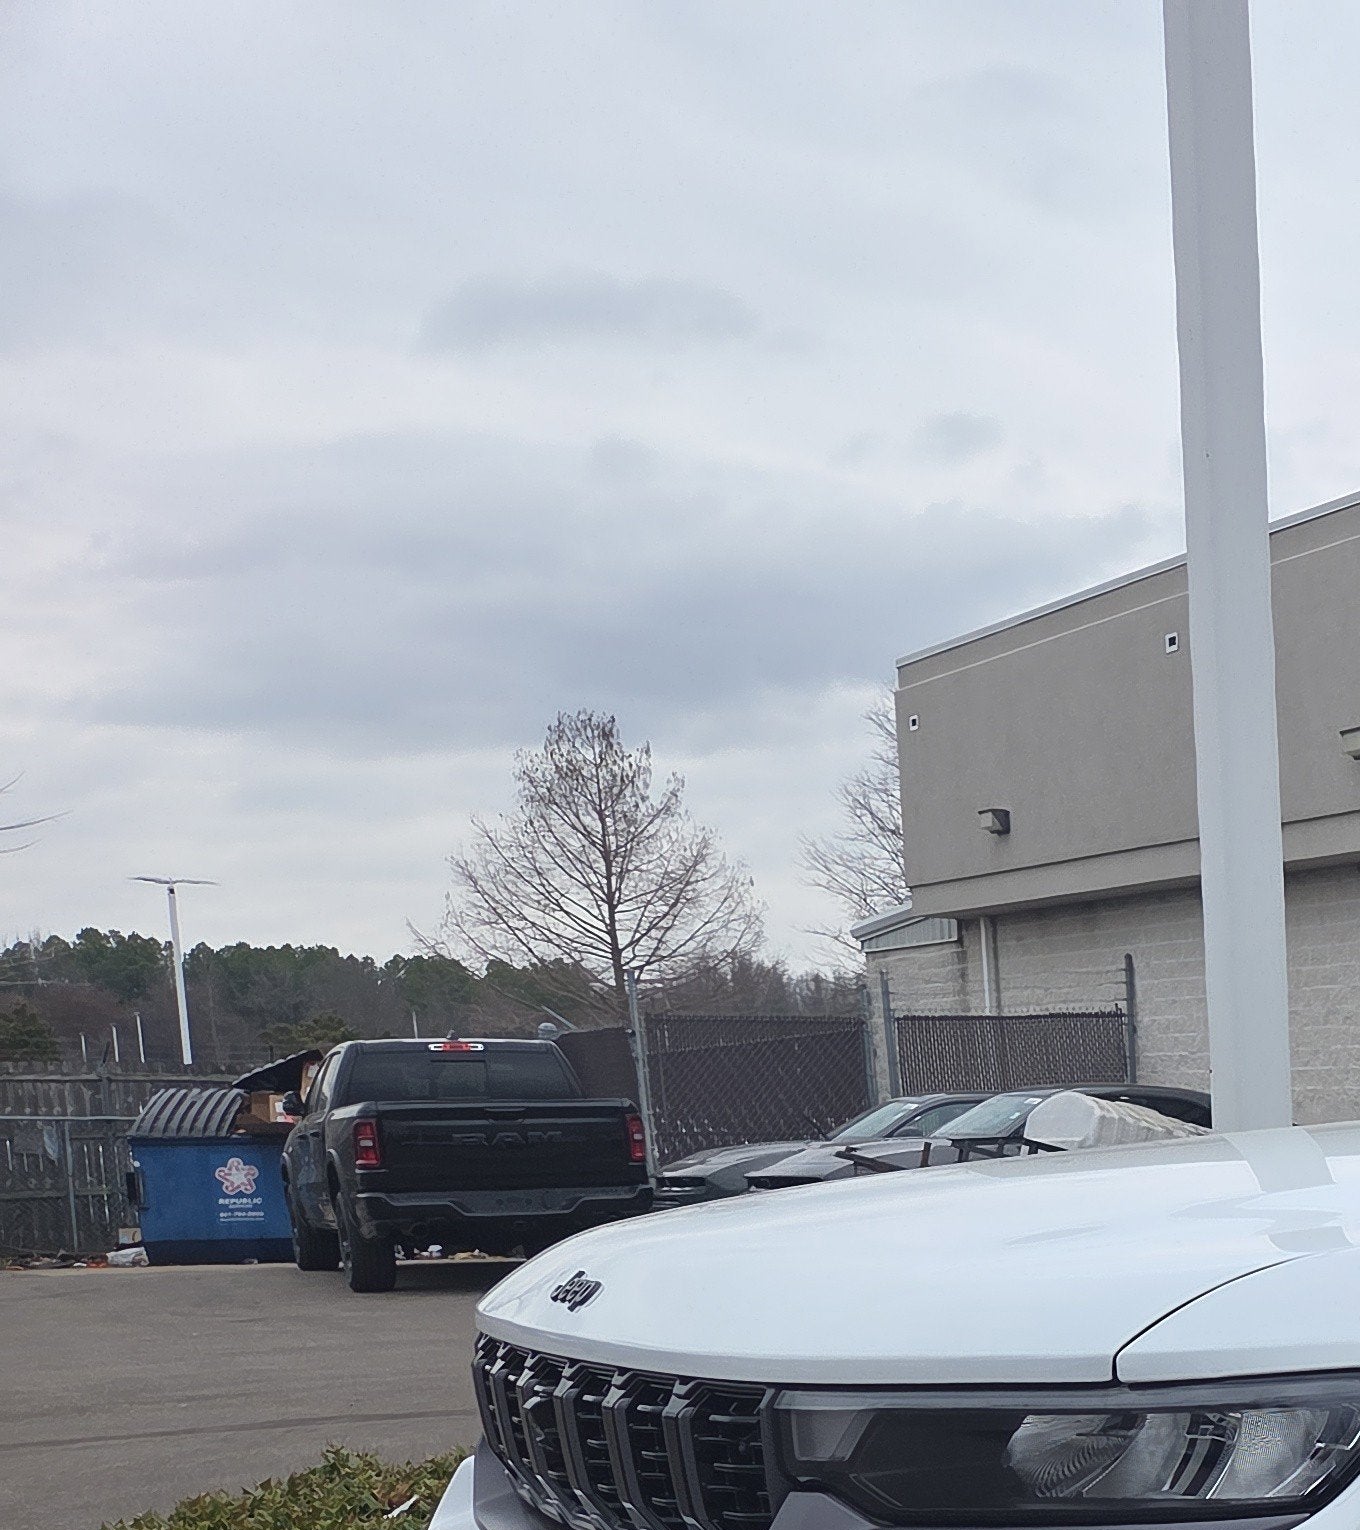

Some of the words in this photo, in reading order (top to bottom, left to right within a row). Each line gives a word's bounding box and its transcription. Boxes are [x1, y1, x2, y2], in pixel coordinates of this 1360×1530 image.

[451, 1130, 562, 1146] RAM
[218, 1197, 263, 1205] REPUBLIC
[550, 1270, 603, 1312] Jeep
